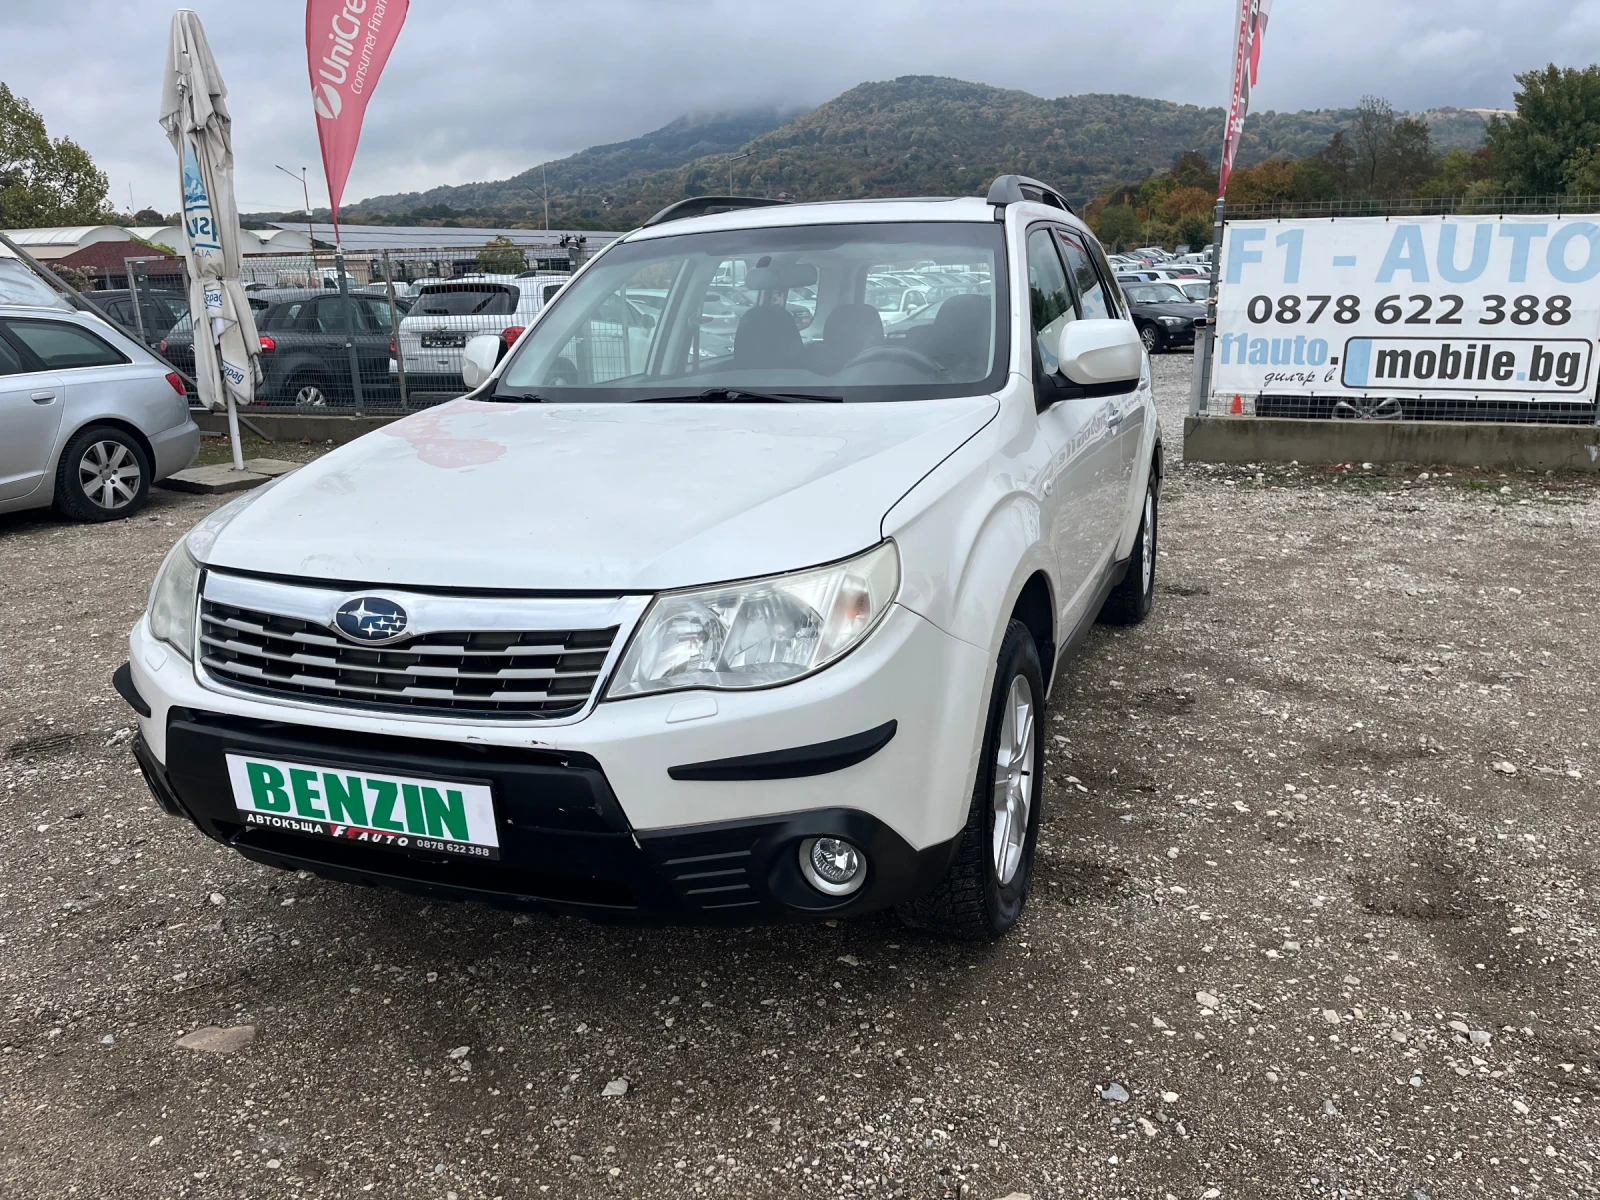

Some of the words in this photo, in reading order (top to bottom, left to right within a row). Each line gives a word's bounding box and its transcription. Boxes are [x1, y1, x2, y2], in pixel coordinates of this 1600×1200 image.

[350, 31, 377, 94] Consumer
[1225, 227, 1305, 285] F1
[1333, 255, 1357, 267] -
[1375, 221, 1600, 284] AUTO
[1246, 294, 1361, 325] 0878
[1374, 294, 1464, 325] 622
[1478, 294, 1573, 326] 388
[1375, 343, 1581, 387] mobile.bg
[246, 762, 470, 842] BENZIN
[246, 813, 324, 834] АВТОКЪЩА
[357, 831, 409, 847] AUTO
[416, 839, 445, 851] 0878
[446, 843, 467, 854] 622
[468, 846, 490, 857] 388
